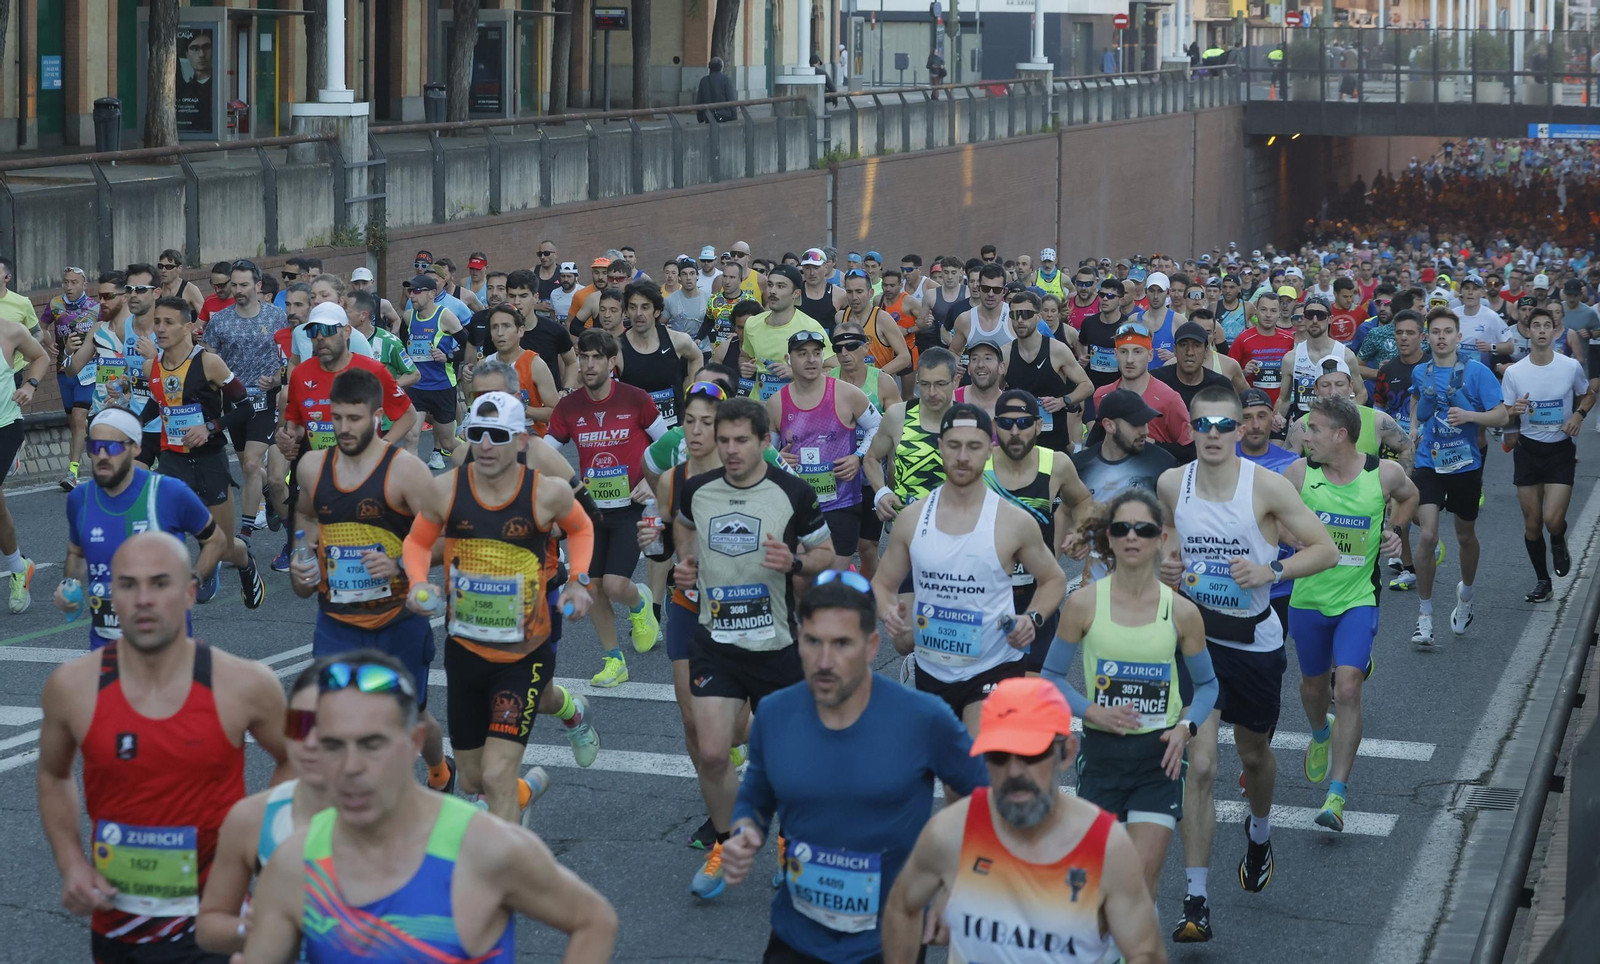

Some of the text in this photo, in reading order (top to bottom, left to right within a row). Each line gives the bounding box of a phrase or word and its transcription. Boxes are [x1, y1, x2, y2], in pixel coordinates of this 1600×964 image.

[172, 406, 197, 415] ZURICH
[578, 428, 630, 442] ISBILYA
[1441, 439, 1464, 449] ZURICH
[1441, 455, 1464, 466] MARK
[596, 468, 622, 477] ZURICH
[804, 464, 830, 472] ZURICH
[592, 488, 621, 499] TXOKO
[1333, 517, 1365, 527] ZURICH
[1187, 536, 1241, 545] SEVILLA
[1333, 531, 1349, 540] 1761
[1184, 546, 1250, 556] MARATHON
[346, 565, 365, 574] 4708
[921, 570, 976, 583] SEVILLA
[330, 579, 350, 589] ALEX
[473, 581, 511, 593] ZURICH
[1209, 582, 1229, 591] 5077
[727, 586, 762, 598] ZURICH
[474, 600, 493, 609] 1588
[1196, 591, 1239, 607] ERWAN
[729, 604, 748, 615] 3081
[475, 614, 517, 627] MARATÓN
[938, 609, 975, 623] ZURICH
[712, 613, 773, 631] ALEJANDRO
[937, 626, 957, 637] 5320
[922, 634, 973, 655] VINCENT
[1122, 664, 1163, 677] ZURICH
[1121, 684, 1143, 695] 3571
[519, 662, 543, 737] LA GAVIA
[126, 830, 185, 846] ZURICH
[130, 857, 158, 871] 1627
[816, 851, 869, 870] ZURICH
[817, 875, 845, 890] 4489
[794, 884, 869, 912] ESTEBAN
